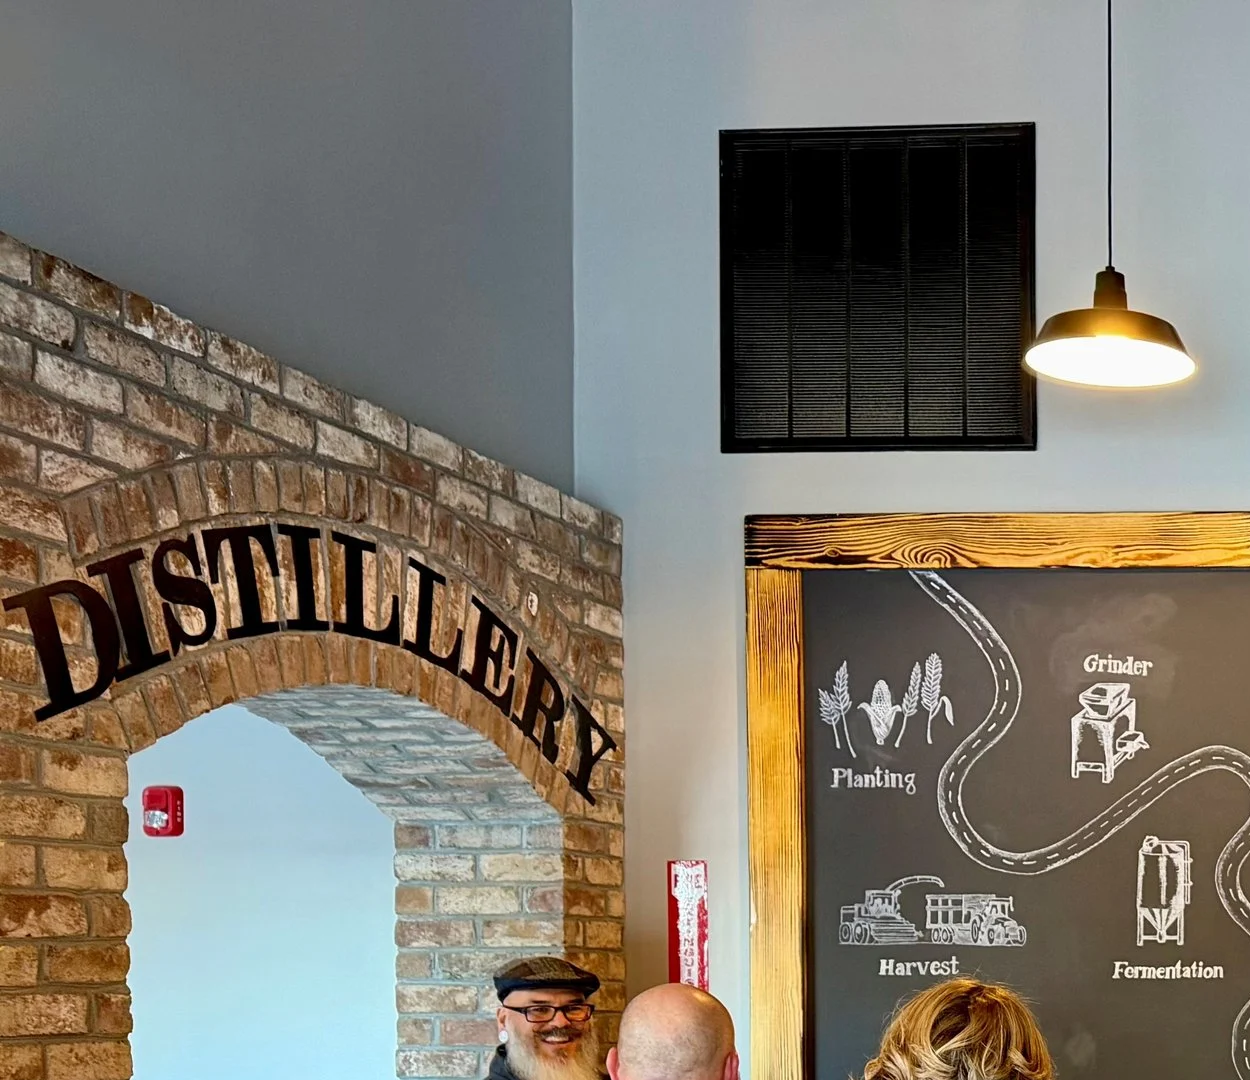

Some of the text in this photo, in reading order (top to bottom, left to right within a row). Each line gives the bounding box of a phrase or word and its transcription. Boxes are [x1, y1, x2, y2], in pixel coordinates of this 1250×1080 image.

[2, 524, 617, 804] DISTILLERY
[1083, 654, 1153, 677] Grinder
[830, 766, 916, 795] Planting
[878, 956, 960, 977] Harvest
[1112, 960, 1224, 980] Fermentation
